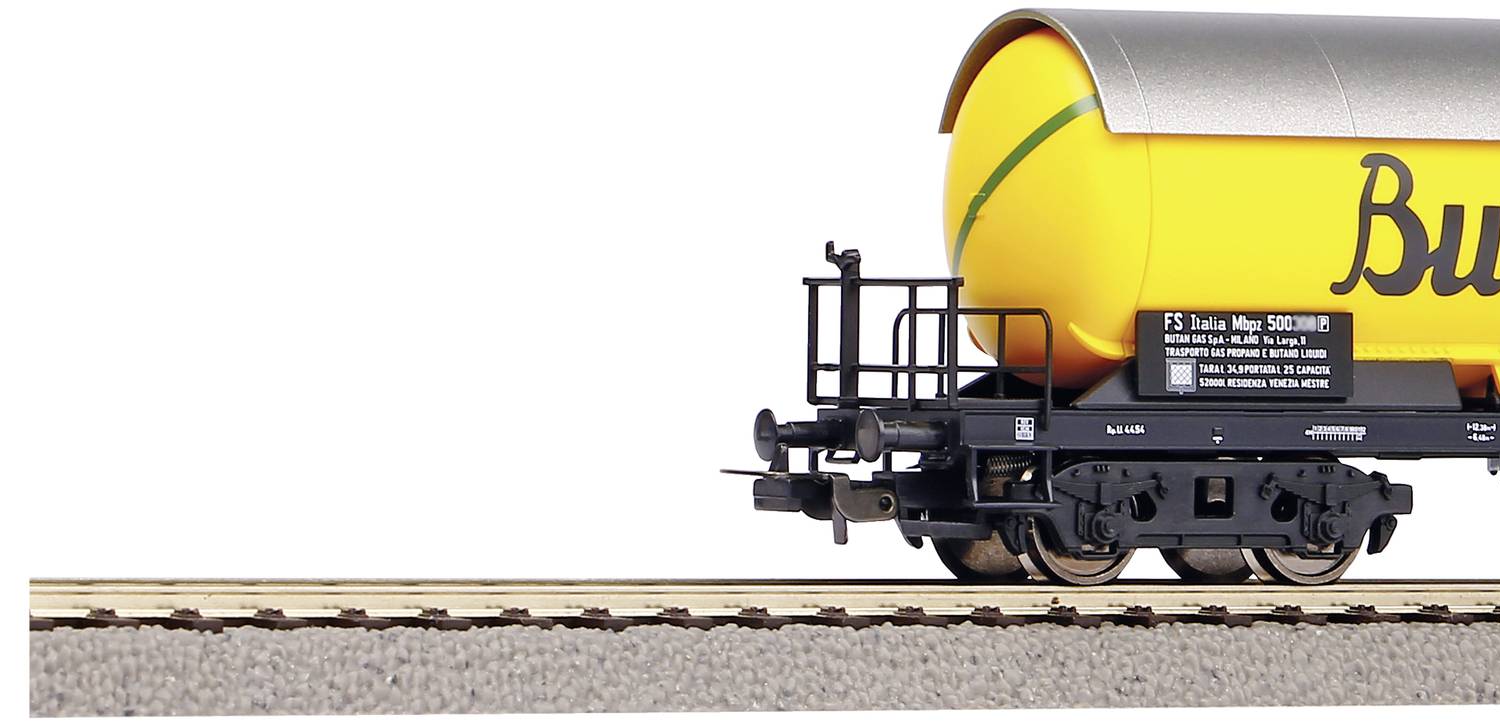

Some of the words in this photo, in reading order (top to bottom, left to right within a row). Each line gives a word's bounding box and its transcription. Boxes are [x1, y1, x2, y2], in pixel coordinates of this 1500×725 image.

[1164, 312, 1184, 331] FS
[1190, 313, 1227, 331] Italia
[1231, 314, 1263, 336] Mbpz
[1164, 333, 1190, 344] BUTAN
[1191, 334, 1207, 344] GAS
[1207, 334, 1225, 346] SpA
[1230, 334, 1259, 345] MILANO
[1263, 335, 1274, 345] Via
[1164, 347, 1209, 357] TRASPORTO
[1210, 348, 1226, 358] GAS
[1226, 348, 1260, 358] PROPANO
[1261, 348, 1268, 358] E
[1269, 348, 1299, 359] BUTANO
[1283, 364, 1294, 375] 25
[1227, 377, 1267, 388] RESIDENZA
[1268, 378, 1299, 389] VENEZIA
[1300, 378, 1330, 389] MESTRE
